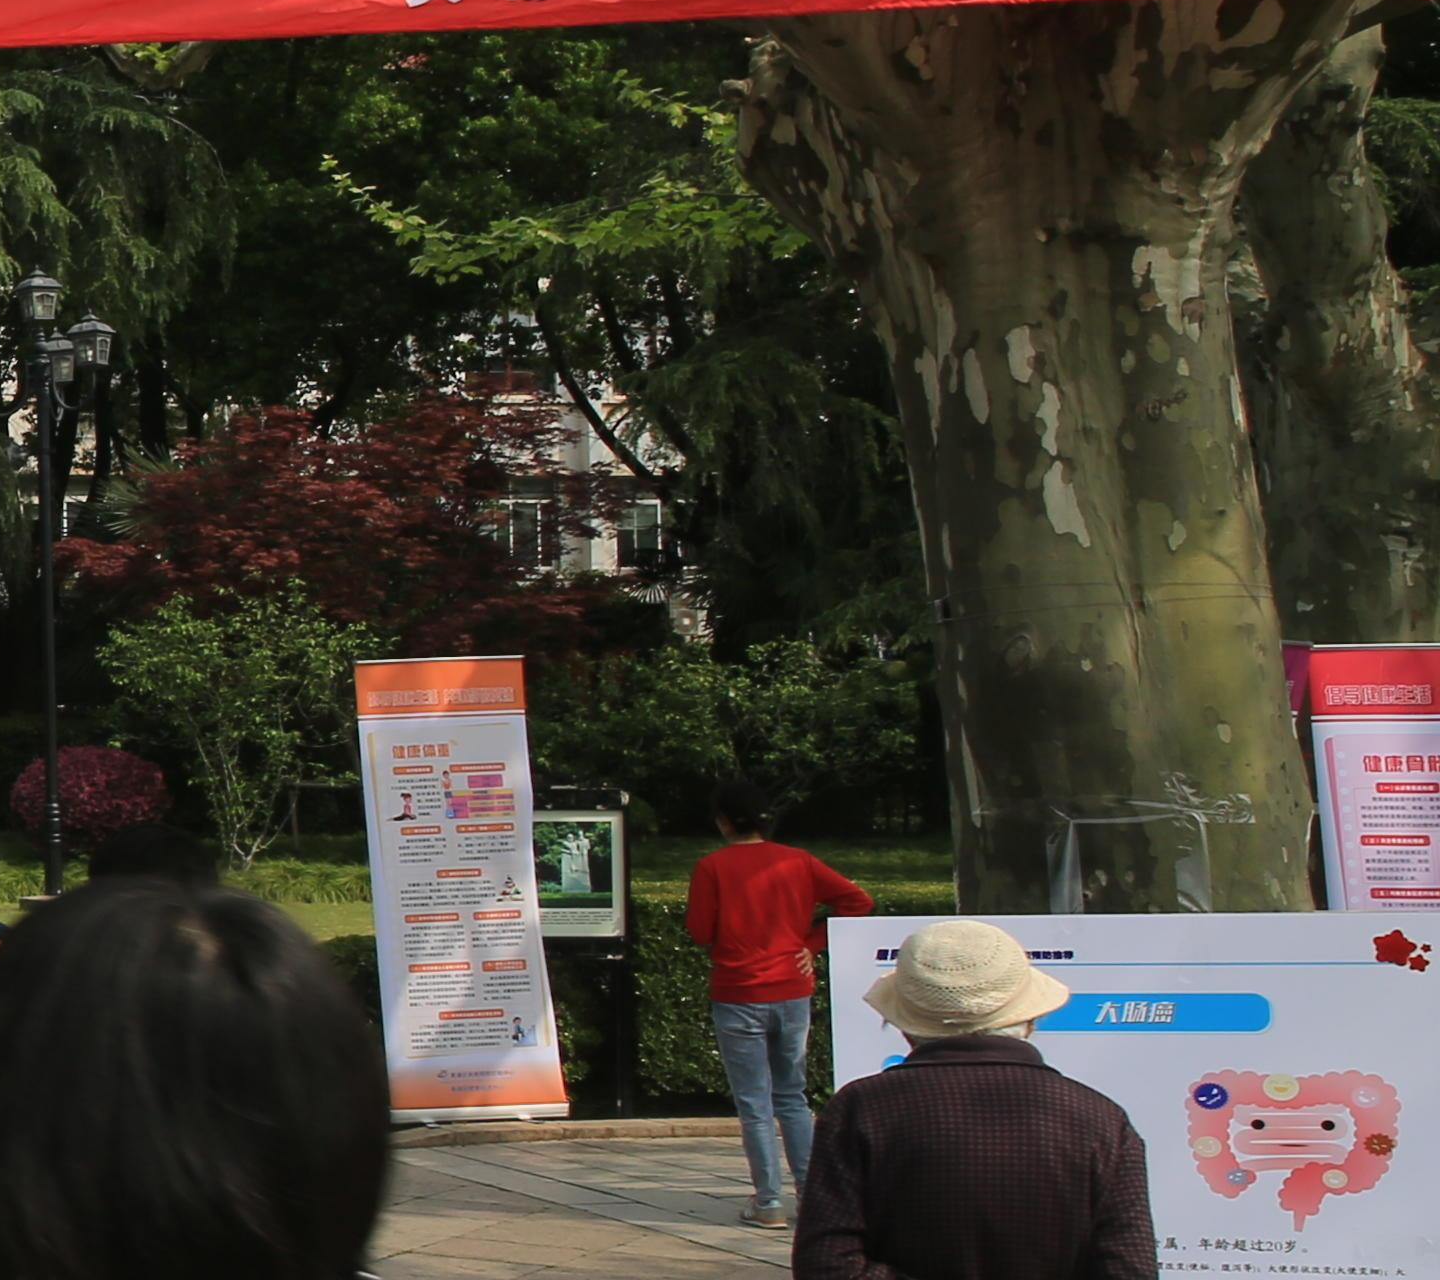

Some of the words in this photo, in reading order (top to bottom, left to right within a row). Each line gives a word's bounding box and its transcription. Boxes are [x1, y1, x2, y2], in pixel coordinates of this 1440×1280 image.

[1323, 684, 1432, 705] 倡导健康生活
[1094, 1000, 1178, 1025] 大肠癌
[1154, 1238, 1308, 1254] 属，年龄超过20岁。
